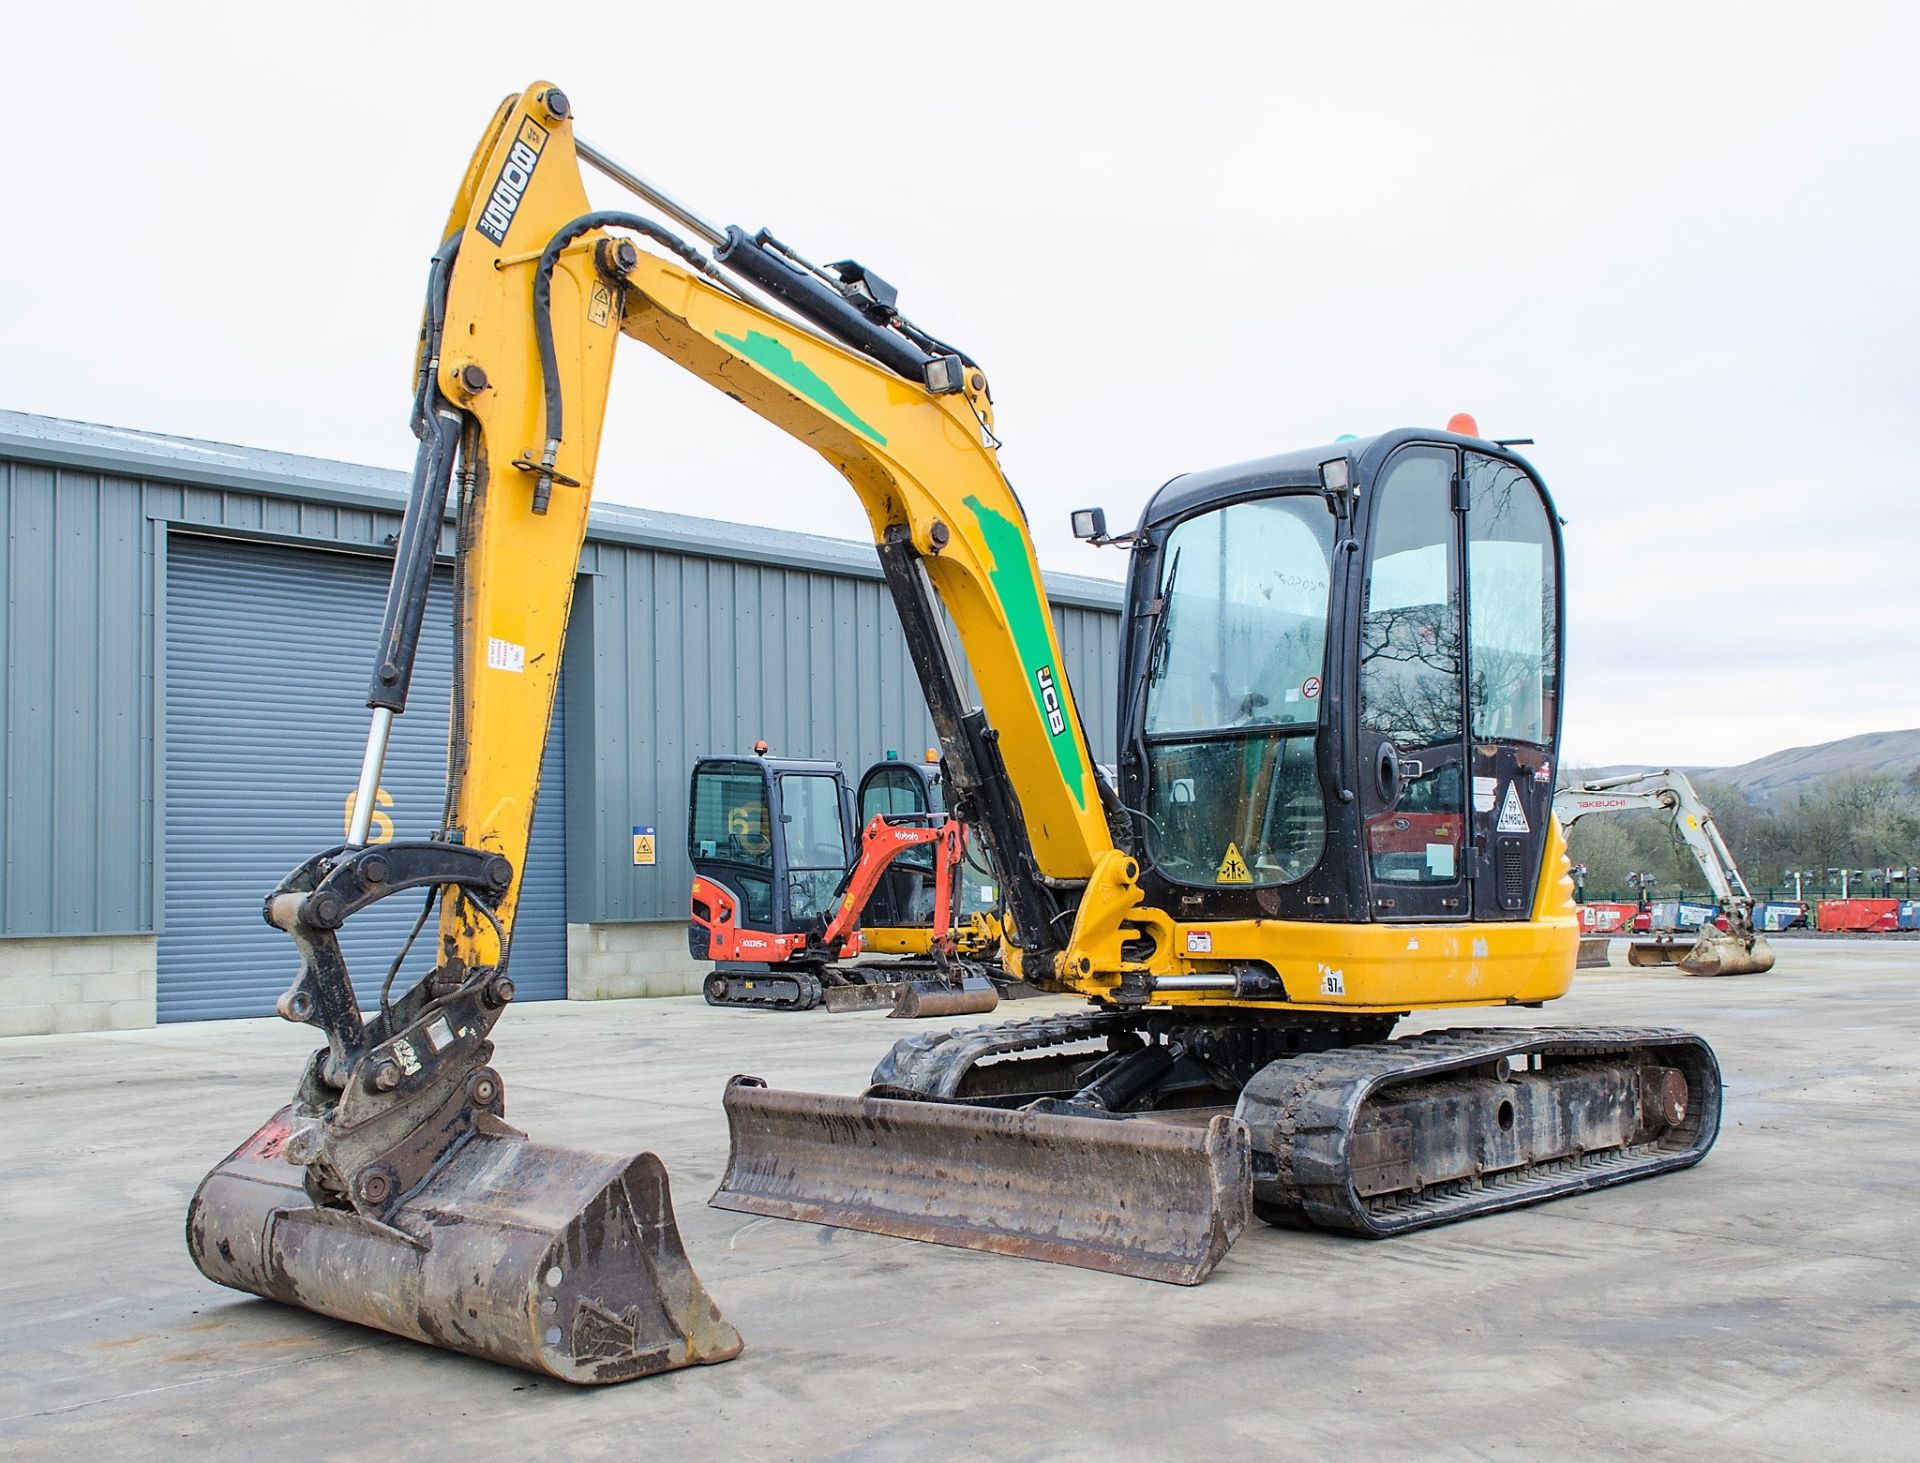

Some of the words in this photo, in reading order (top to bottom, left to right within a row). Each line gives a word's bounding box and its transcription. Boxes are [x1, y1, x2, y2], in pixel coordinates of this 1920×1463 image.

[484, 140, 537, 232] 8055
[480, 218, 504, 241] RTS
[1037, 666, 1066, 736] JCB
[895, 831, 918, 841] Kubota
[1327, 977, 1338, 993] 97
